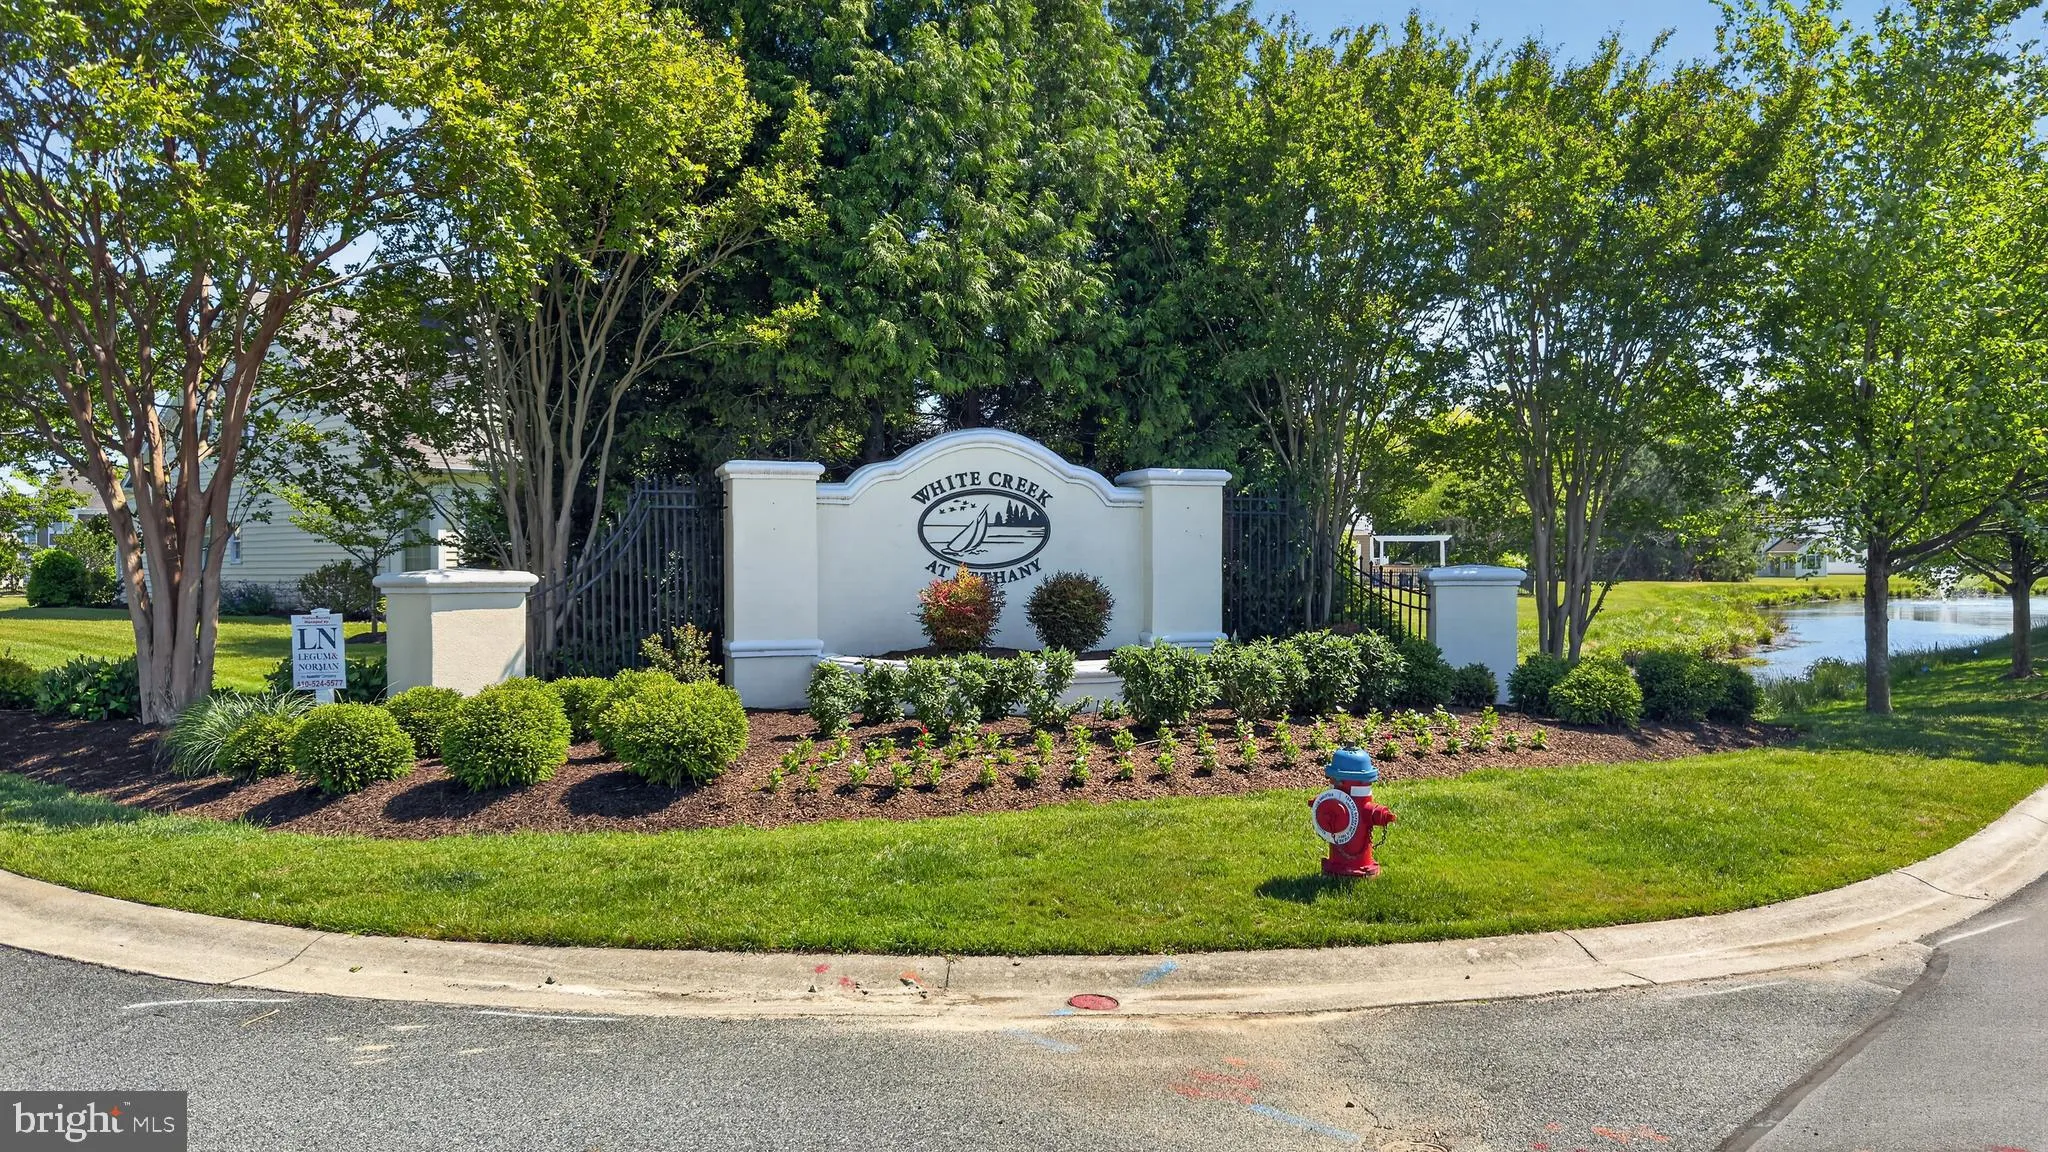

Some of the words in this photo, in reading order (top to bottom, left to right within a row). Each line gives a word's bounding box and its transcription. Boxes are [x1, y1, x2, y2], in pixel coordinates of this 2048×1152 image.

[911, 471, 981, 504] WHITE
[989, 471, 1053, 508] CREEK
[925, 560, 951, 578] AT
[298, 628, 337, 650] LN
[298, 663, 339, 671] NORMAN
